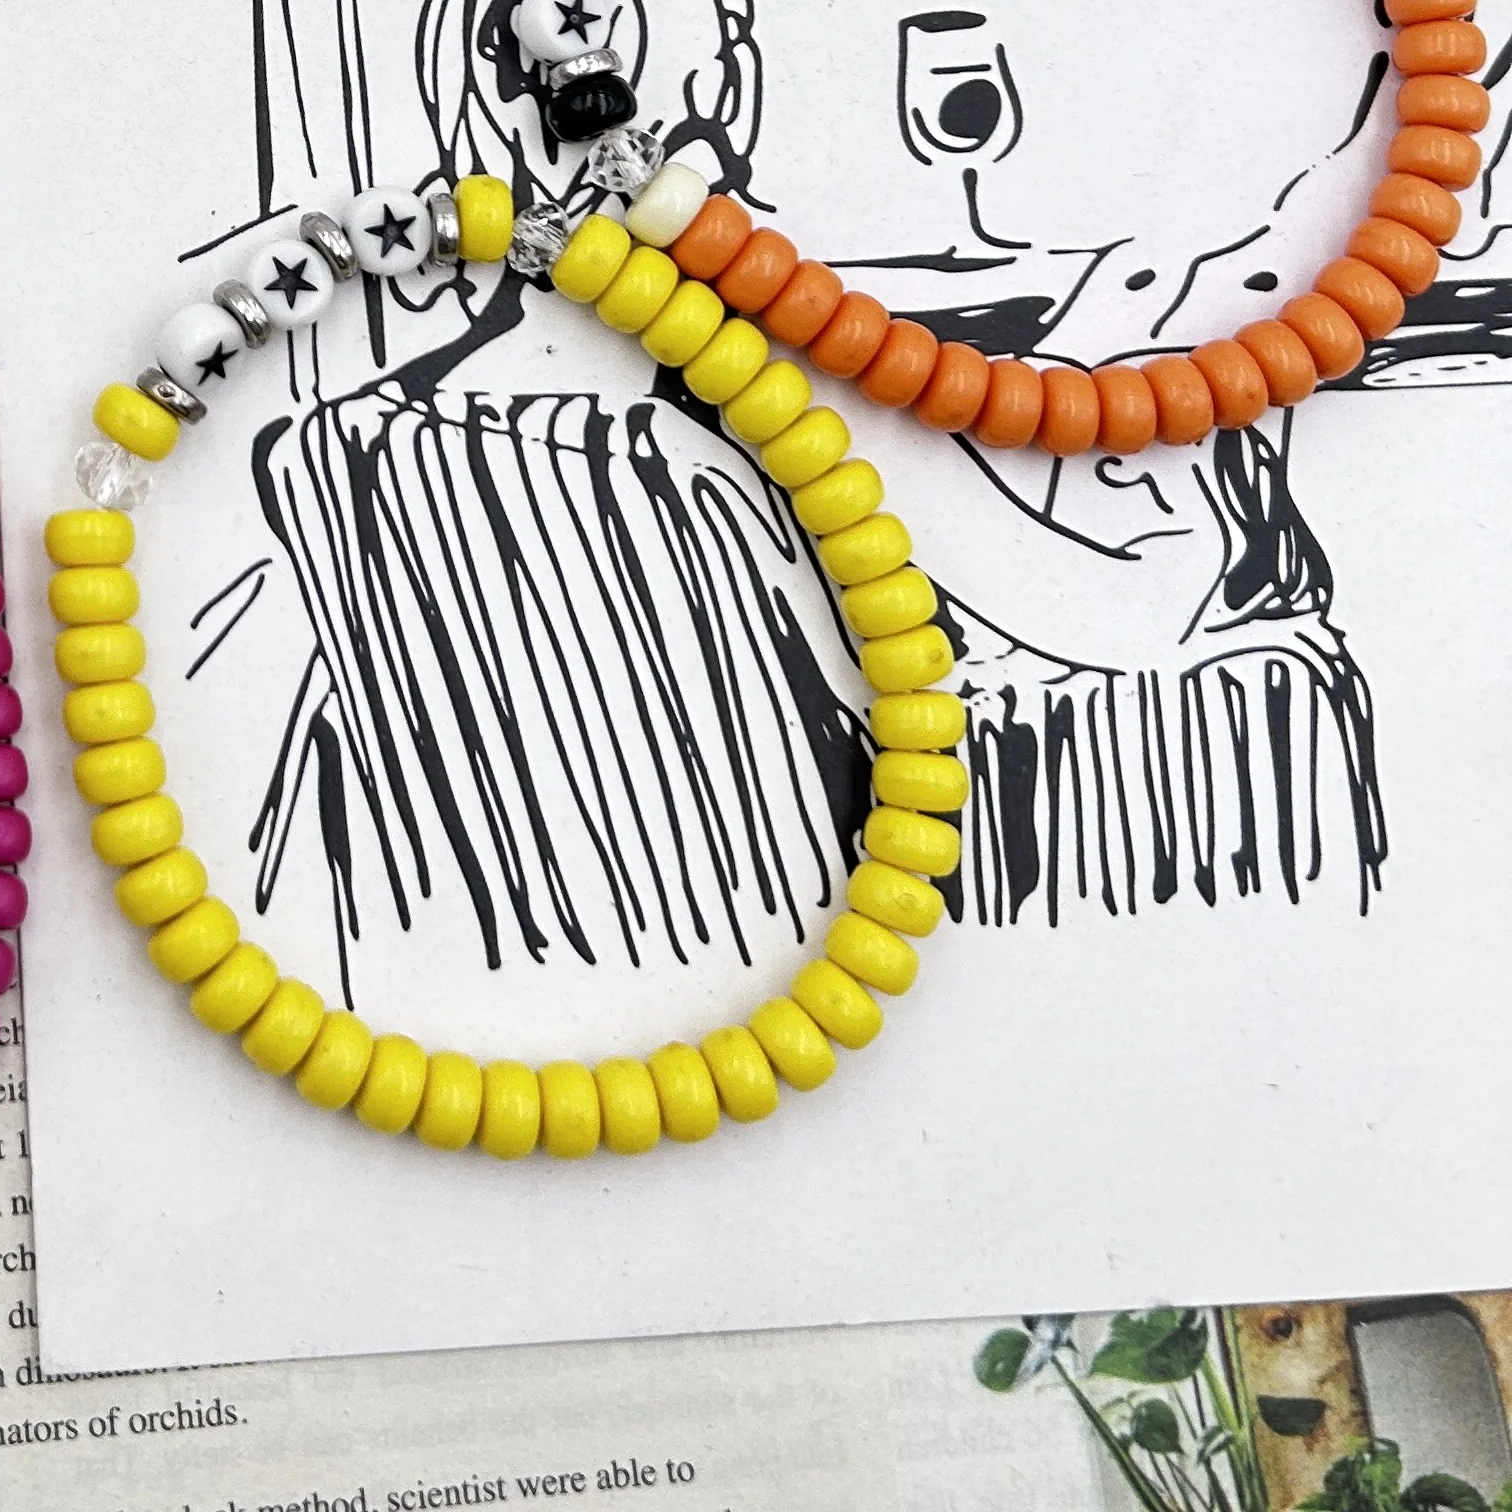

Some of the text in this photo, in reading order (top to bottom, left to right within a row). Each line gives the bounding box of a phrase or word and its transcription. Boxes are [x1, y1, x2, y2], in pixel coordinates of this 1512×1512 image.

[129, 1397, 247, 1435] orchids.
[387, 1458, 657, 1512] scientist were able
